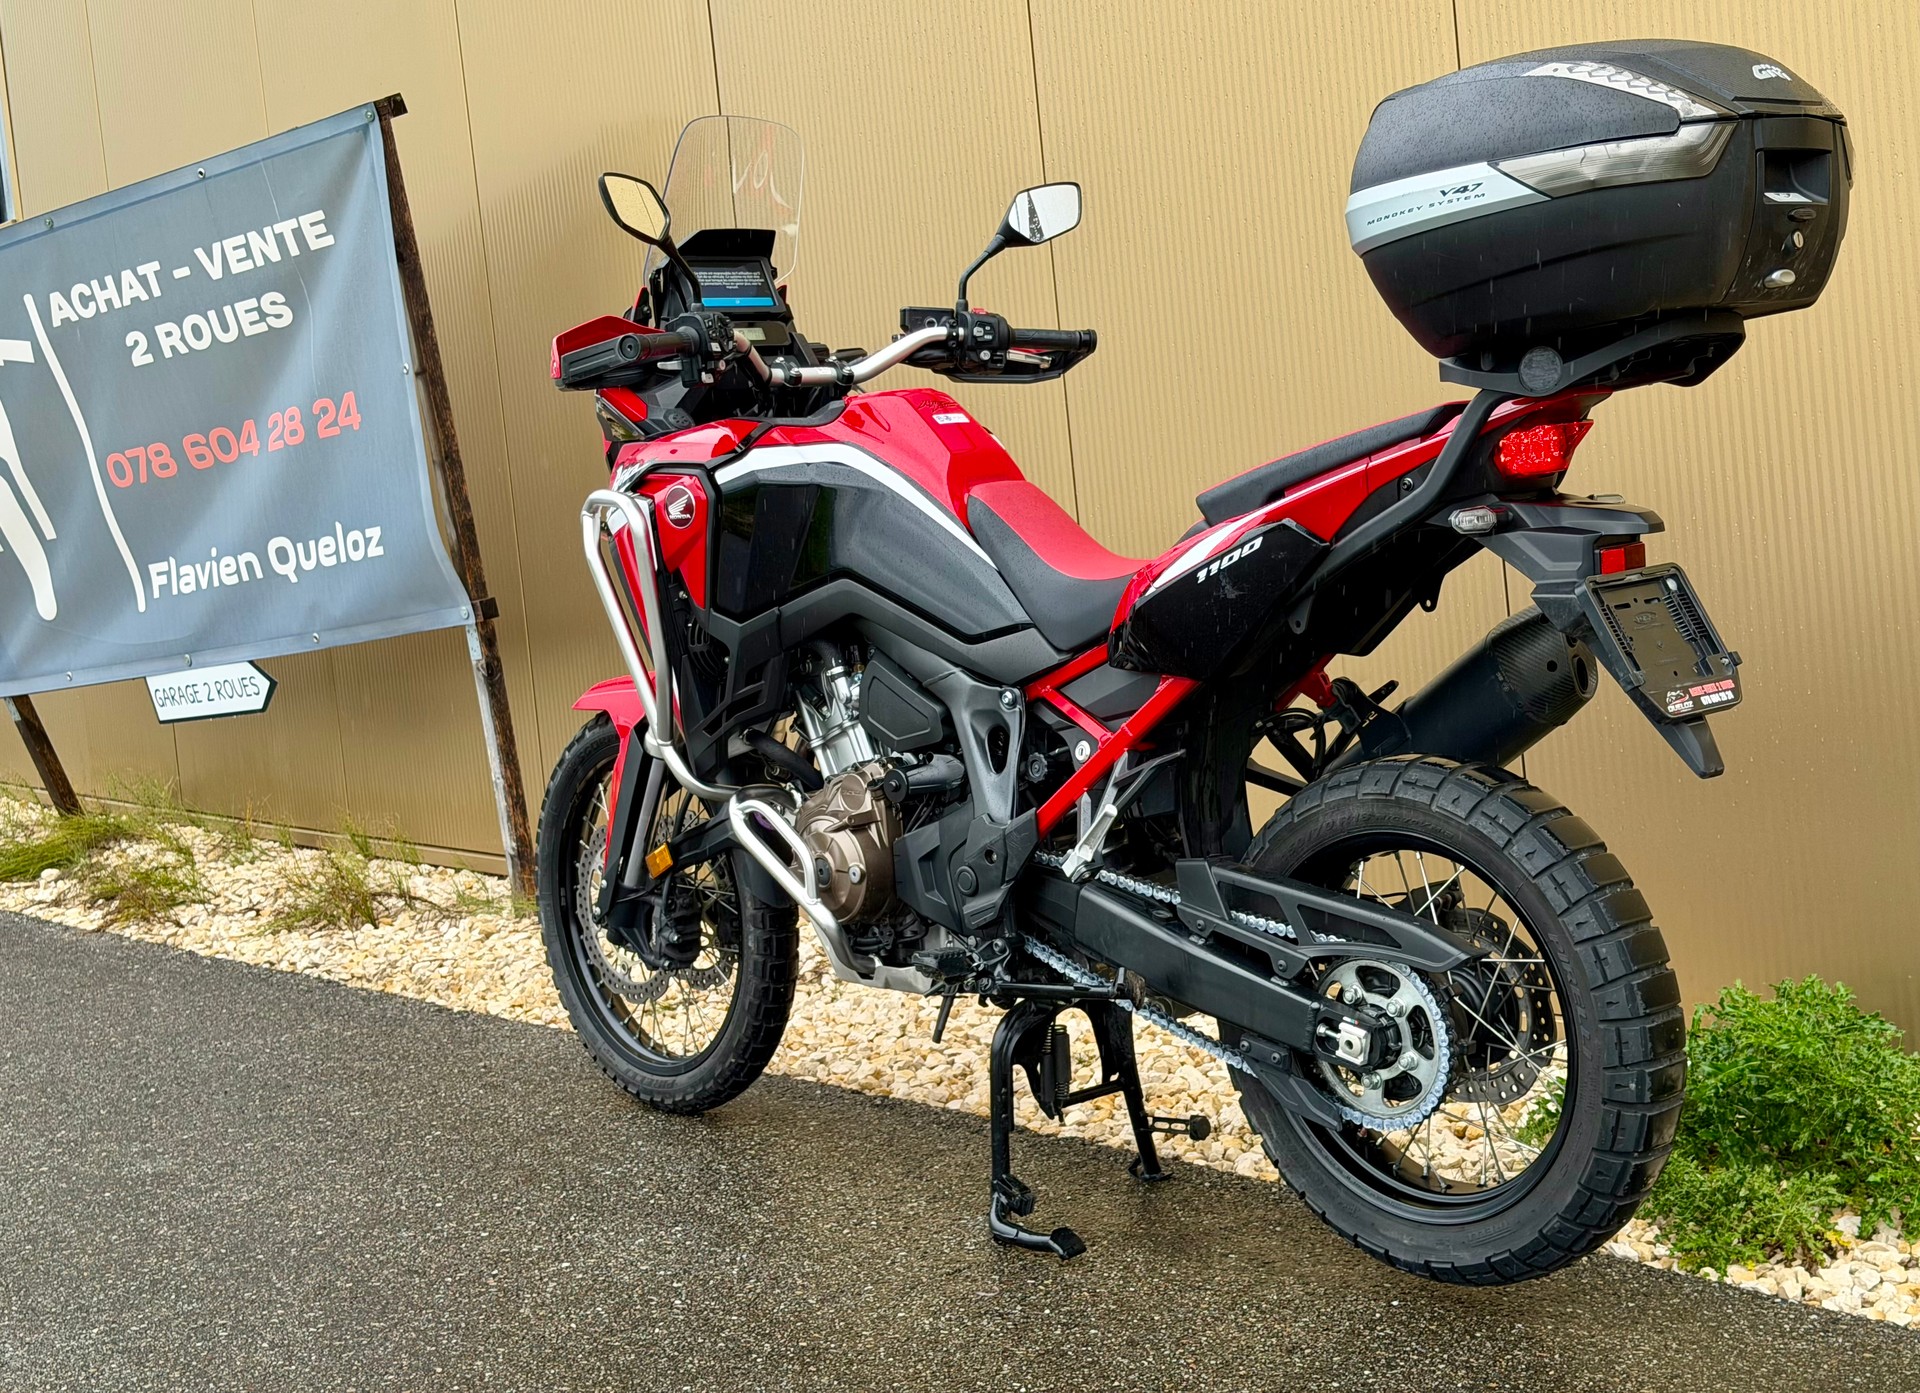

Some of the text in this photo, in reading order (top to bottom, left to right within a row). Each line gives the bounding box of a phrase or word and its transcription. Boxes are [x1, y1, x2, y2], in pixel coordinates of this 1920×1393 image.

[1366, 193, 1486, 226] MONOKEY SYSTEM
[1440, 182, 1484, 197] V47
[49, 260, 162, 328] ACHAT
[194, 210, 335, 282] VENTE
[125, 291, 294, 367] 2 ROUES
[106, 391, 362, 488] 078 604 28 24
[148, 521, 384, 599] Flavien Queloz
[1196, 536, 1264, 584] 1100
[154, 676, 261, 708] GARAGE 2 ROUES
